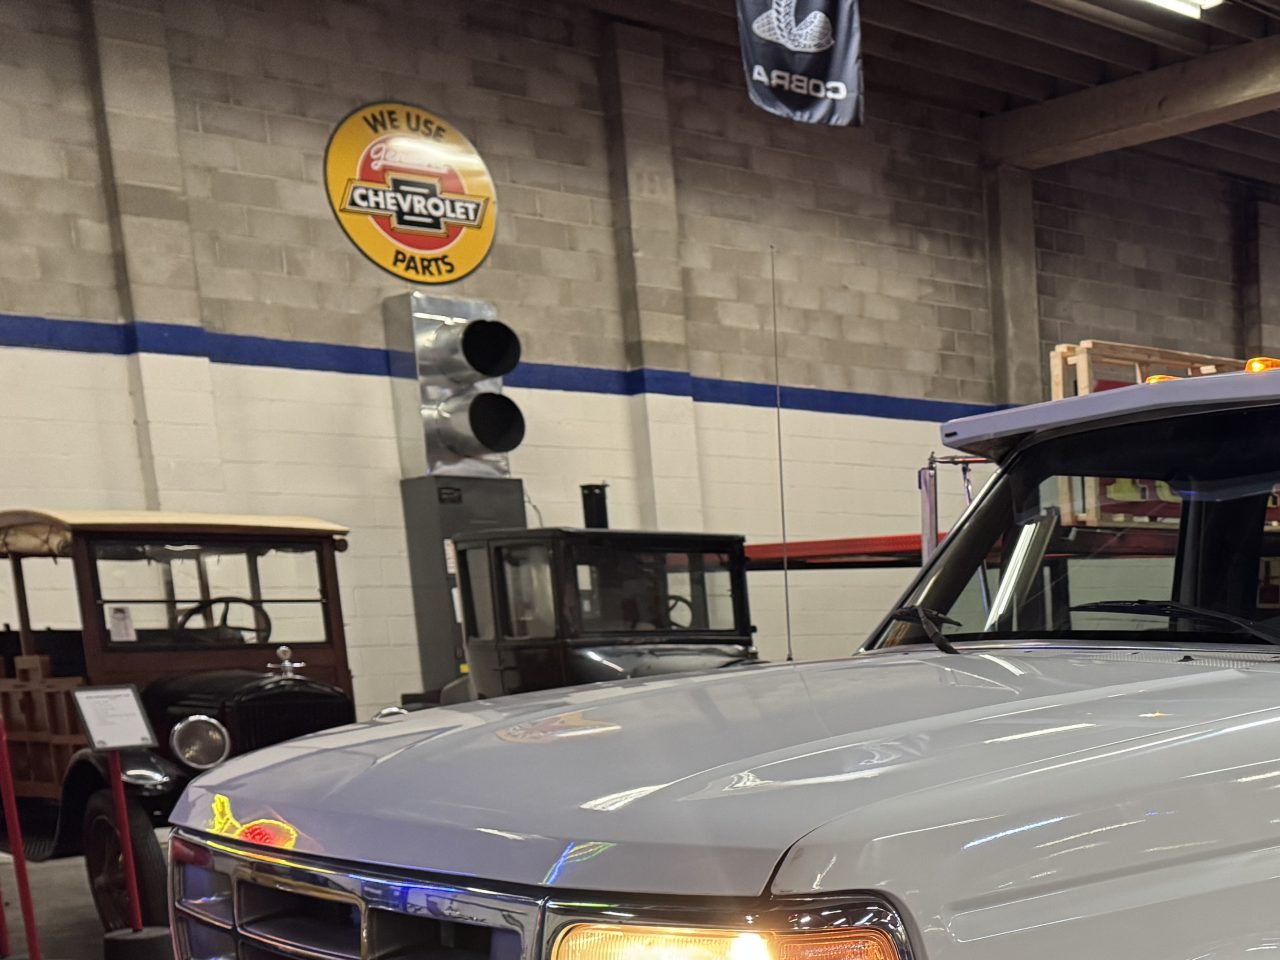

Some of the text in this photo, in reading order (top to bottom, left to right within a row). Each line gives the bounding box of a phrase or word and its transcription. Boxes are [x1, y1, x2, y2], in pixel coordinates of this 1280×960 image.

[363, 110, 446, 140] WE USE
[351, 187, 477, 221] CHEVROLET
[392, 249, 455, 277] PARTS
